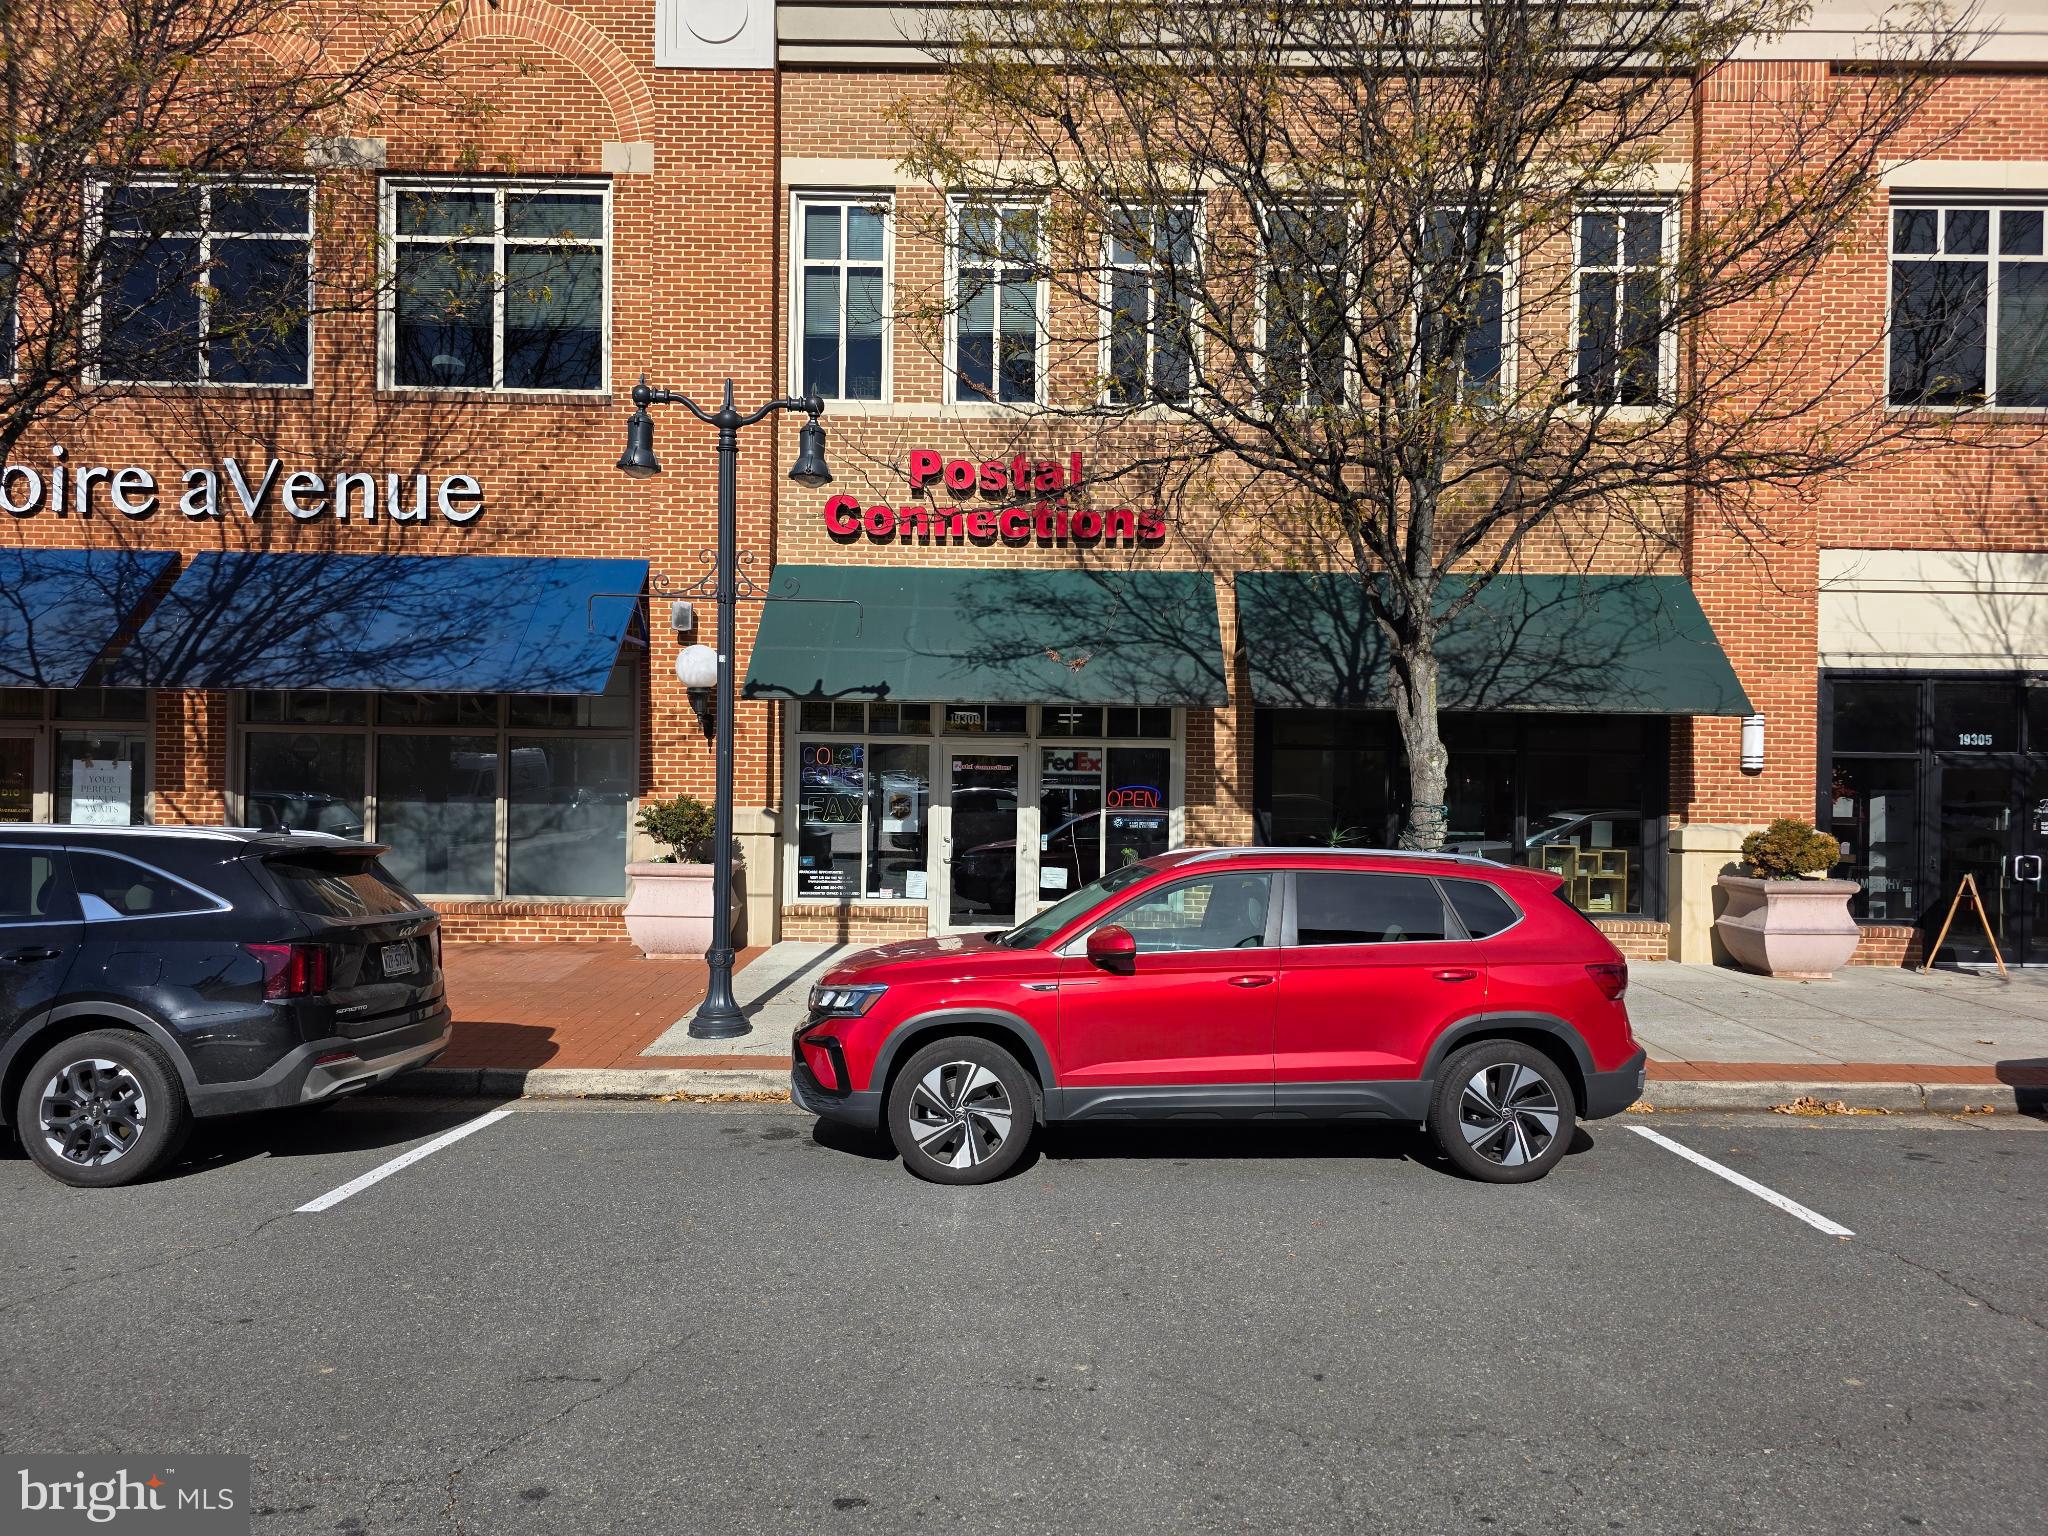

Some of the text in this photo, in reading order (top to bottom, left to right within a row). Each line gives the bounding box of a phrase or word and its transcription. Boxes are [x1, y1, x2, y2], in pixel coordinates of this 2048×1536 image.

[910, 450, 1083, 493] Postal
[1, 445, 483, 521] oire aVenue
[824, 495, 1166, 539] Connections
[1958, 733, 1993, 746] 19305
[1043, 752, 1101, 771] FedEx
[80, 784, 122, 794] PERFECT
[89, 775, 116, 784] YOUR
[85, 804, 119, 813] AWAITS
[1107, 789, 1159, 809] OPEN
[807, 796, 864, 822] FAX
